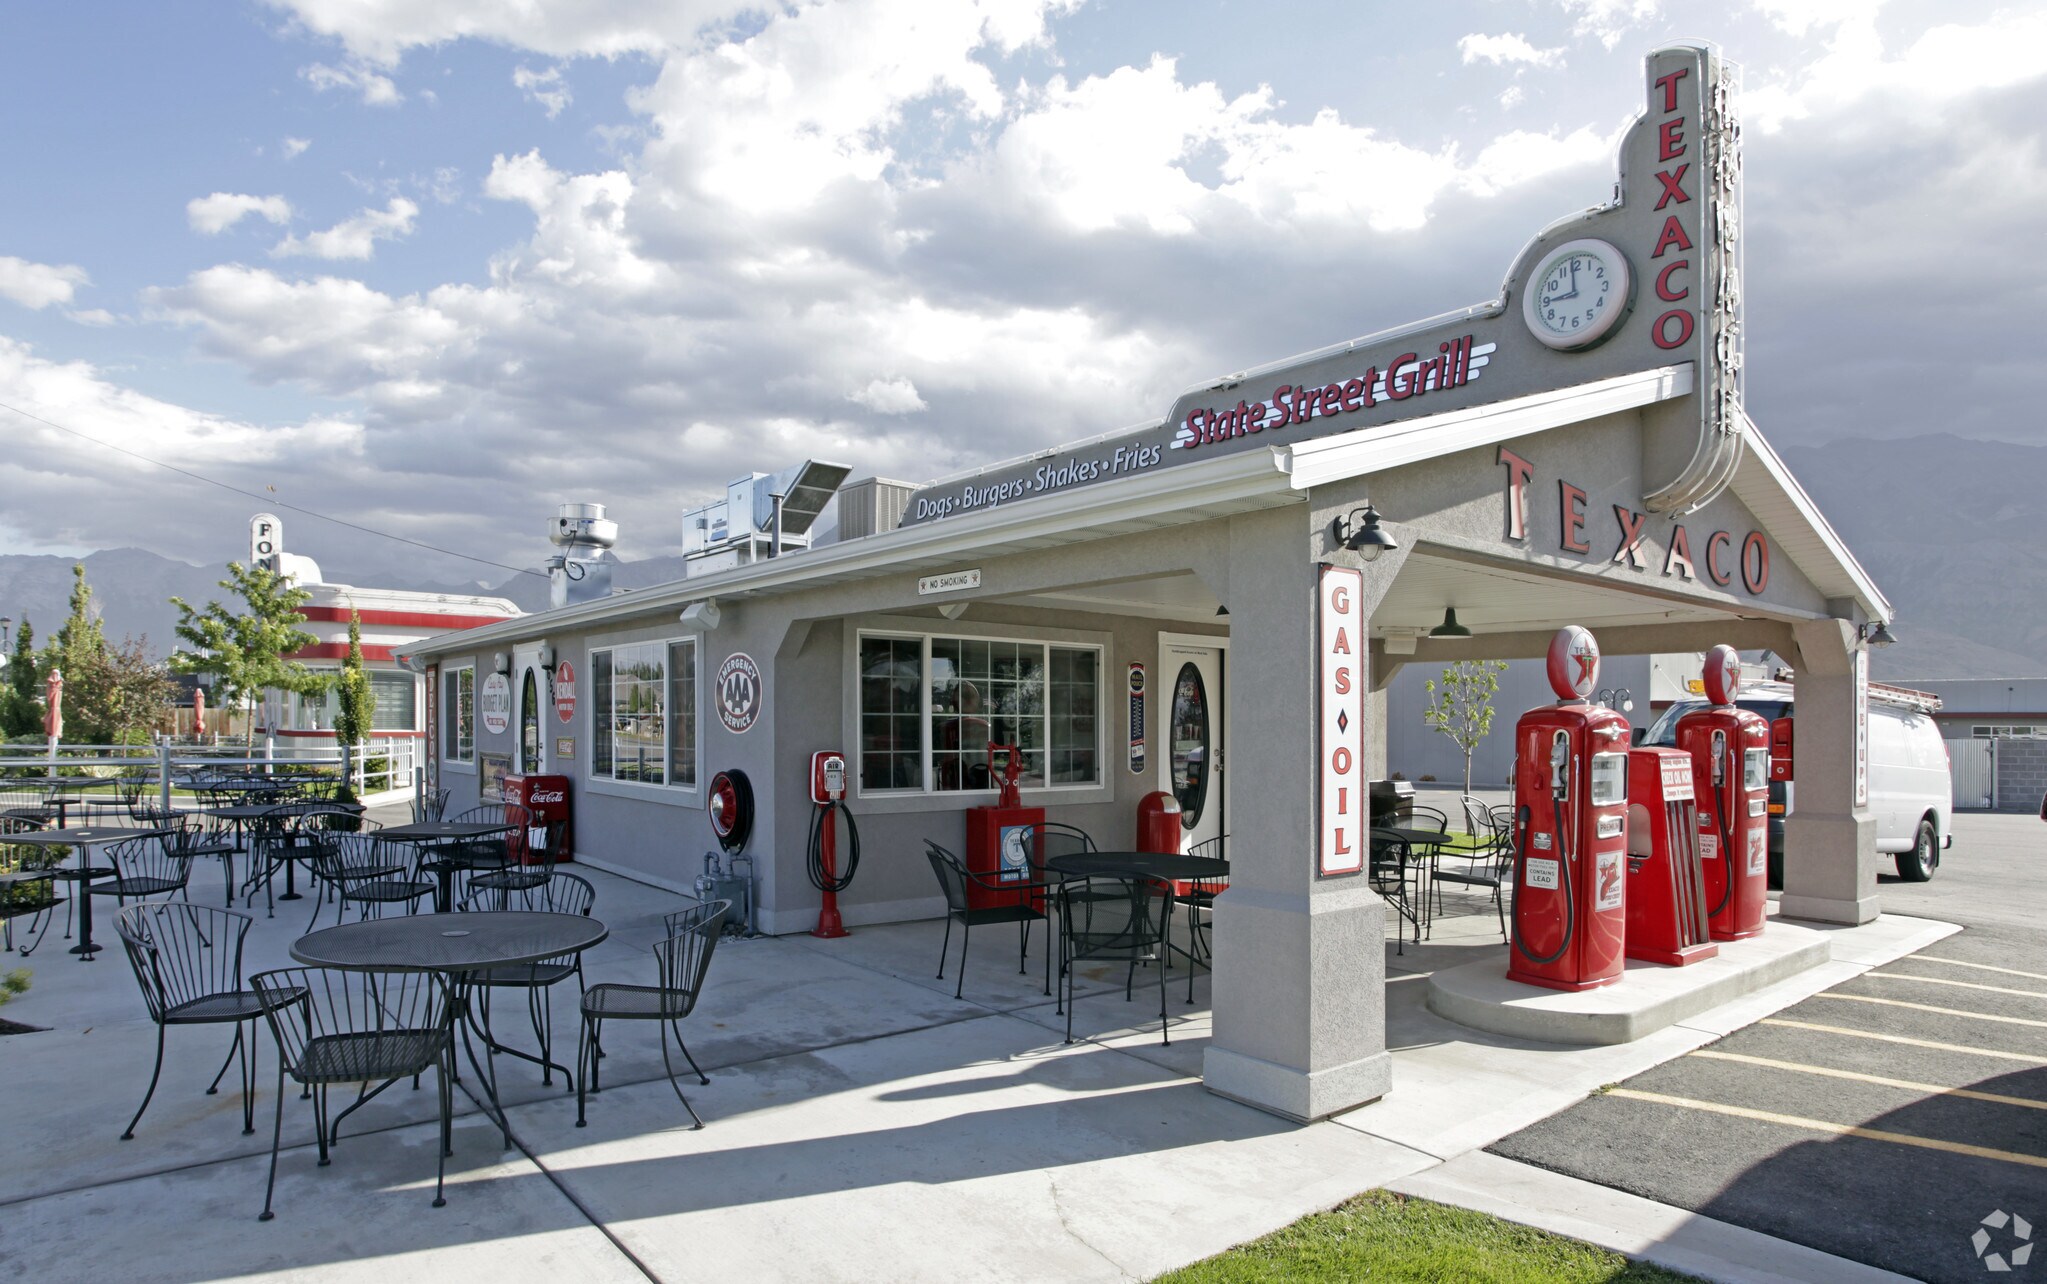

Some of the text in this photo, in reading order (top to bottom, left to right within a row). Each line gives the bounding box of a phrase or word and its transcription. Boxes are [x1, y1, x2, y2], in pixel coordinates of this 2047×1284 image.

[1651, 68, 1694, 350] TEXACO
[1559, 267, 1567, 278] 11
[1596, 267, 1604, 279] 2
[1547, 280, 1559, 292] 10
[1601, 280, 1609, 292] 3
[1543, 296, 1550, 308] 9
[1596, 296, 1603, 307] 4
[1547, 309, 1555, 320] 8
[1586, 309, 1594, 320] 5
[1559, 316, 1567, 328] 7
[1571, 316, 1579, 328] 6
[1183, 334, 1473, 448] State Street Grill
[916, 442, 1162, 520] Dogs Burgers Shakes Fries
[1497, 445, 1770, 595] TEXACO
[930, 575, 968, 589] NO SMOKING
[719, 658, 757, 685] EMERGENCY
[557, 682, 576, 698] KENDALL
[725, 673, 750, 713] AAA
[724, 711, 751, 729] SERVICE
[1331, 586, 1351, 856] GAS OIL
[1529, 868, 1555, 877] CONTAINS
[1533, 875, 1551, 883] LEAD
